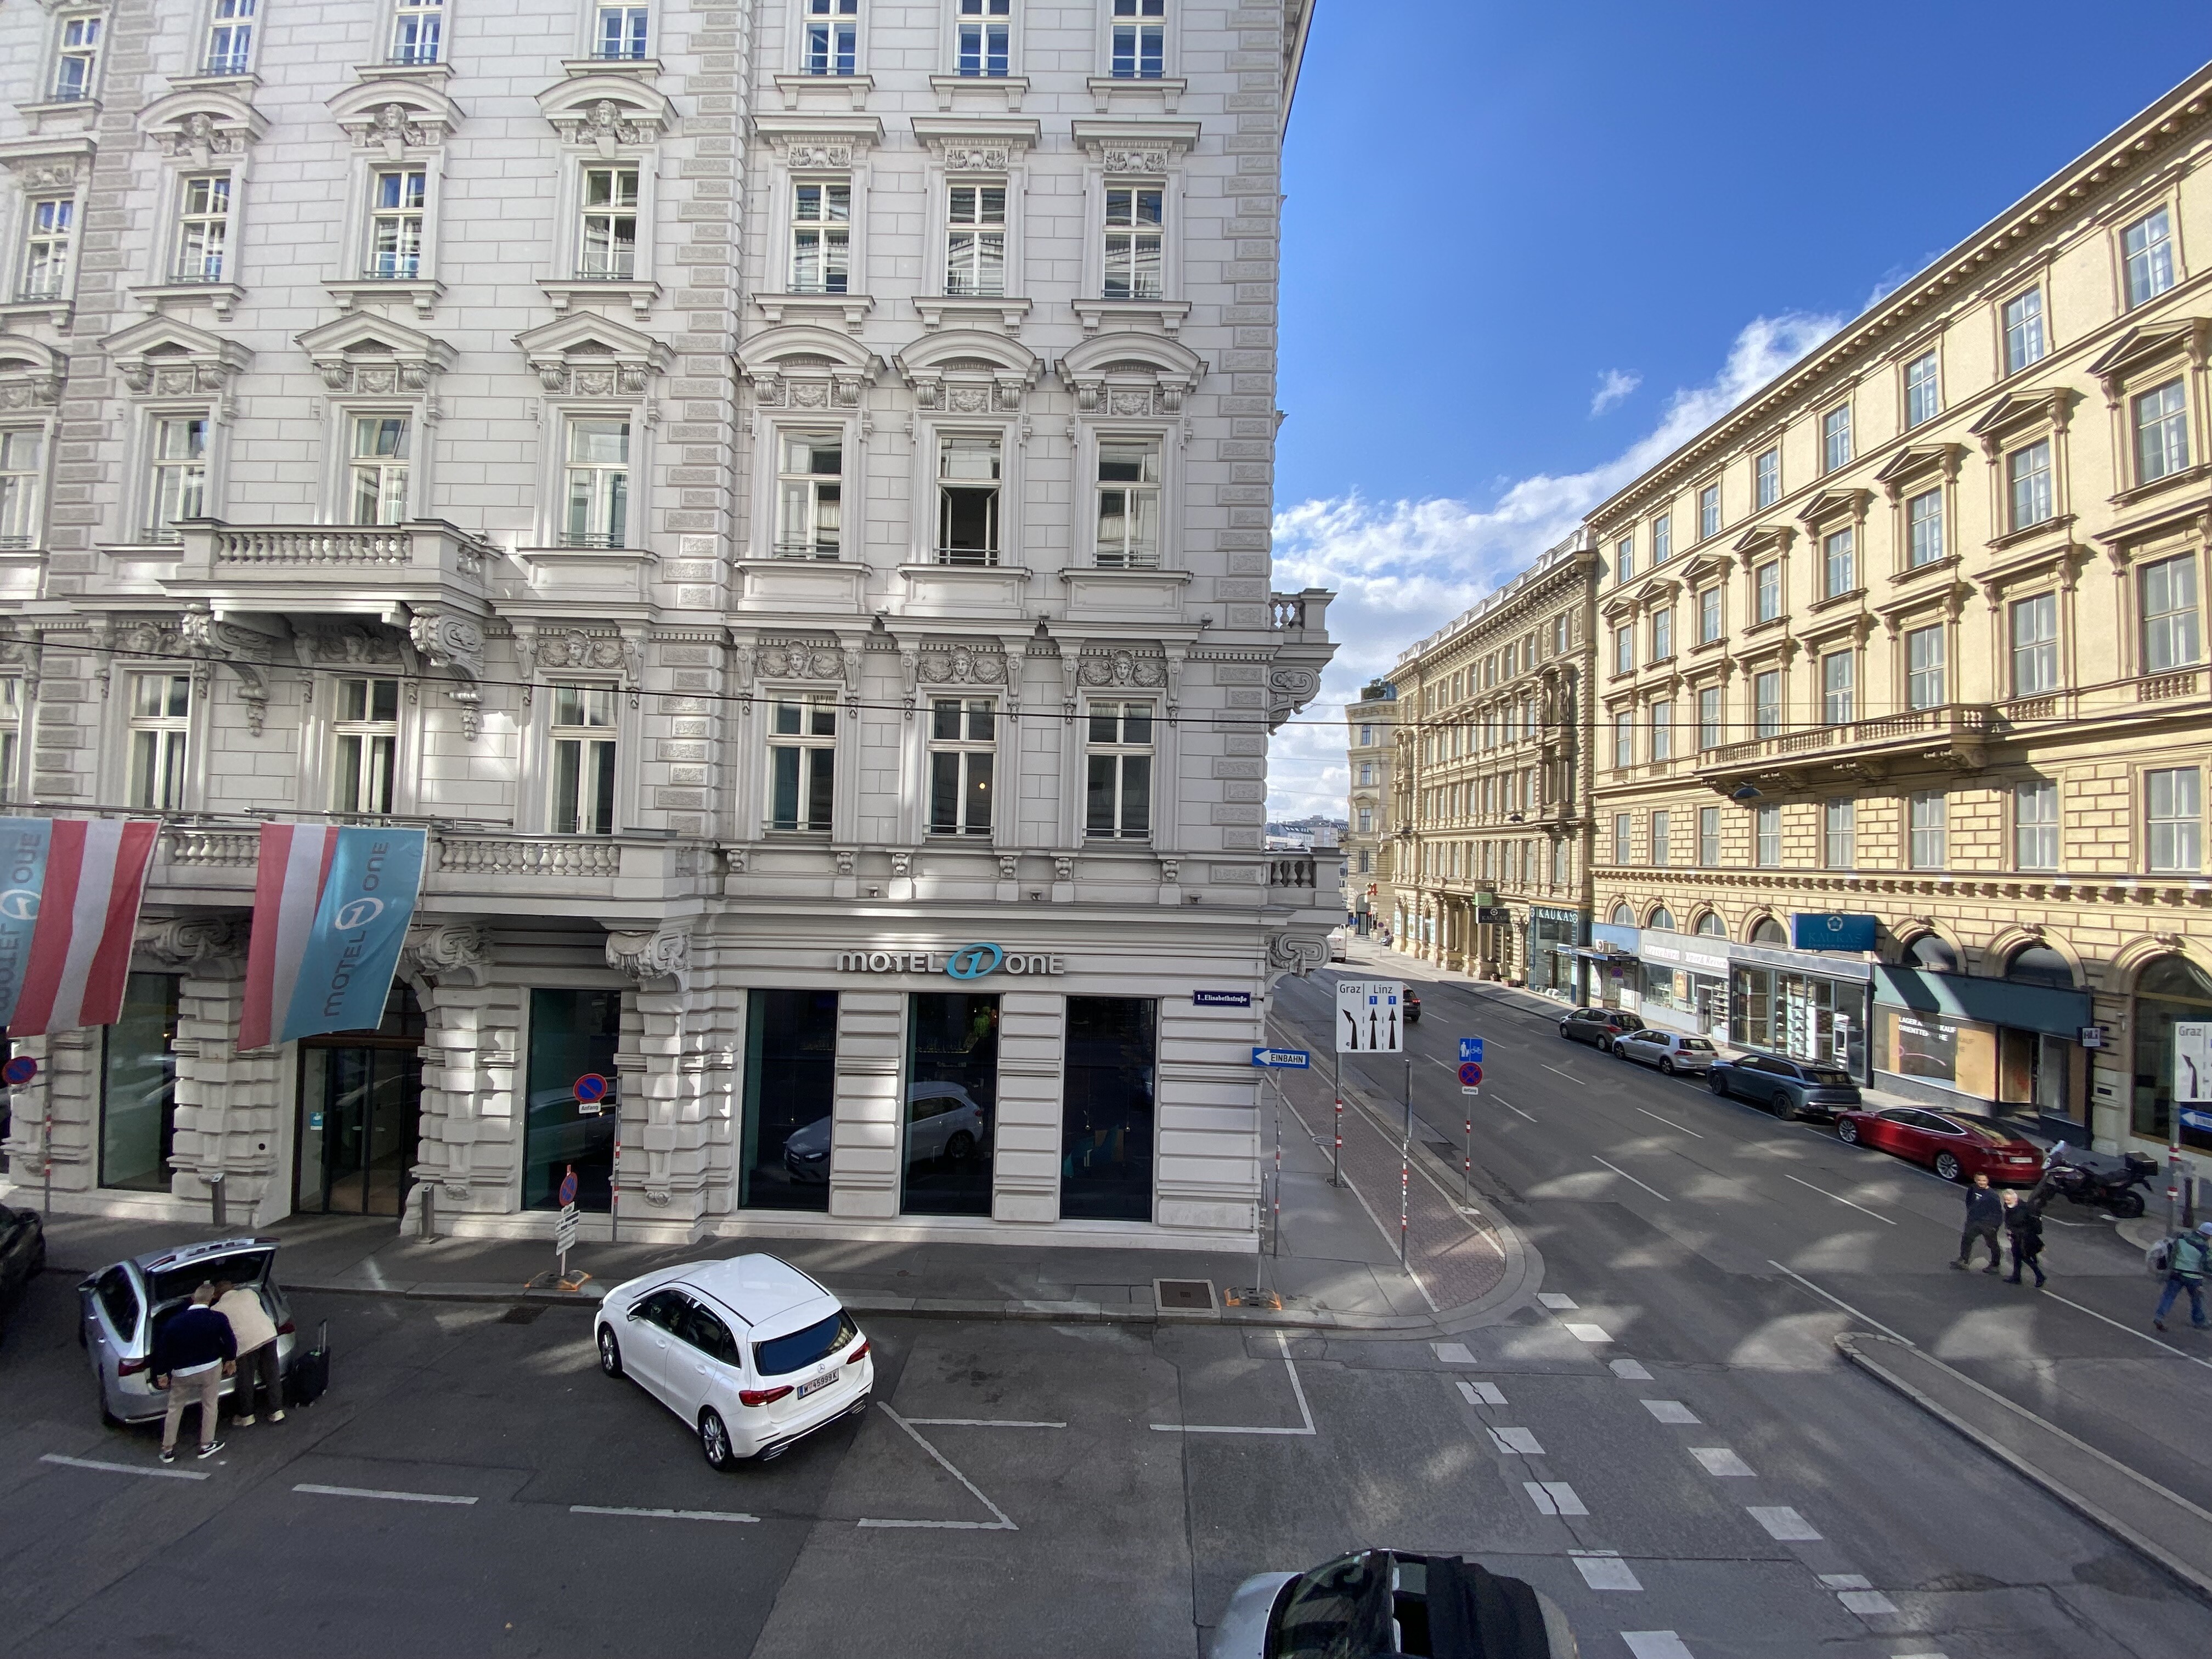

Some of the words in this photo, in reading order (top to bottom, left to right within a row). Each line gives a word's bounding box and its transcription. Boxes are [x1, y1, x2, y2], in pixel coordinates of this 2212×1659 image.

[837, 951, 944, 973] MOTEL
[1005, 952, 1064, 974] ONE
[1340, 984, 1361, 994] Graz
[1374, 984, 1392, 994] Linz
[1899, 1024, 1948, 1041] ORIENTTEPHE
[2179, 1026, 2202, 1036] Graz
[1271, 1053, 1303, 1063] EINBAHN
